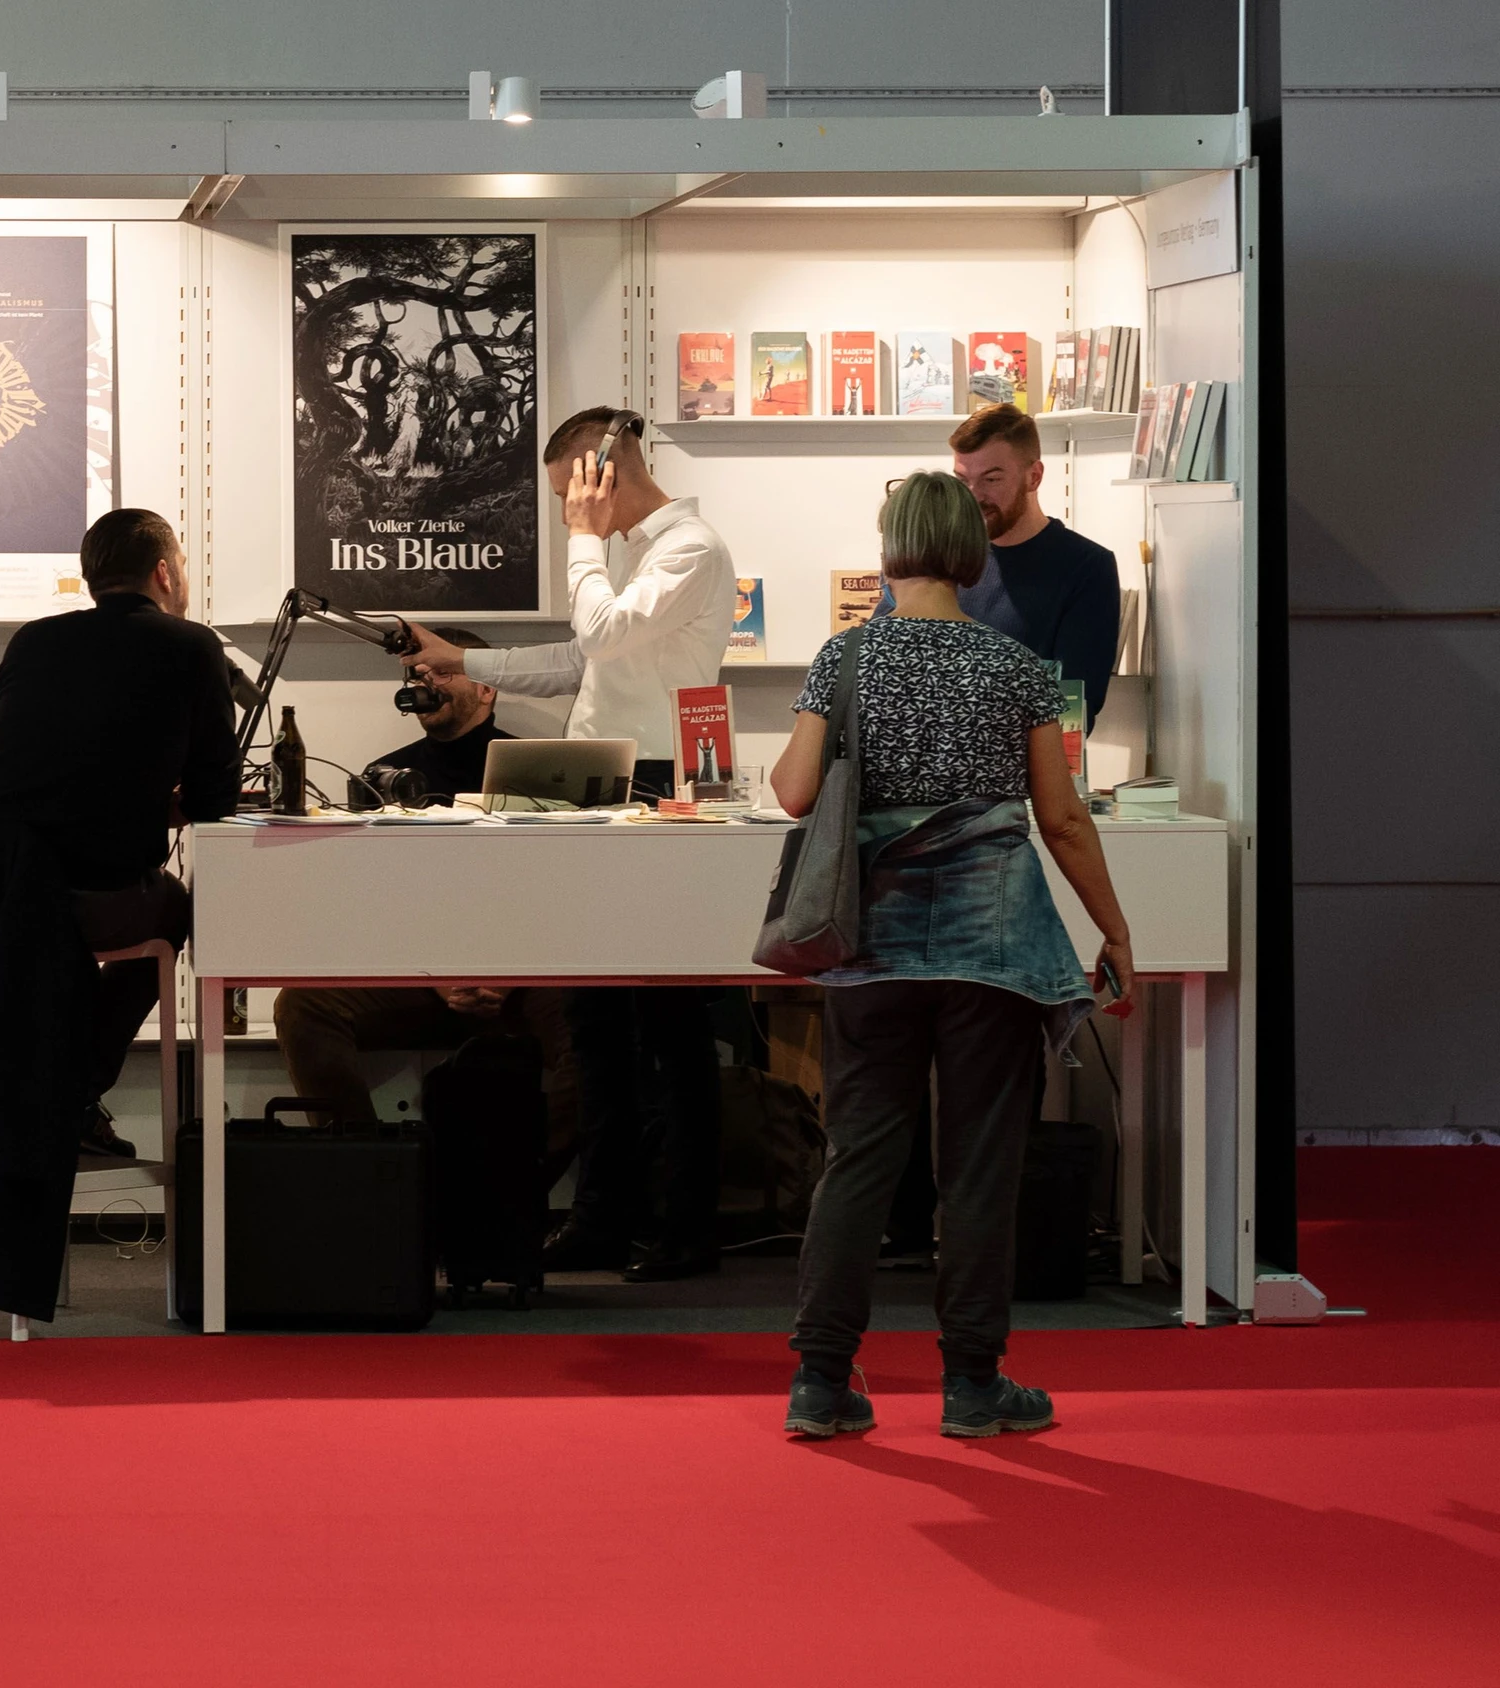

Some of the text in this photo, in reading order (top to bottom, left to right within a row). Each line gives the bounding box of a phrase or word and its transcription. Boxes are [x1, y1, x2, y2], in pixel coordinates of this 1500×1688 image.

[368, 519, 466, 534] Volker Zierke
[330, 538, 504, 571] Ins Blaue
[843, 578, 858, 589] SEA
[692, 704, 727, 714] KADETTEN
